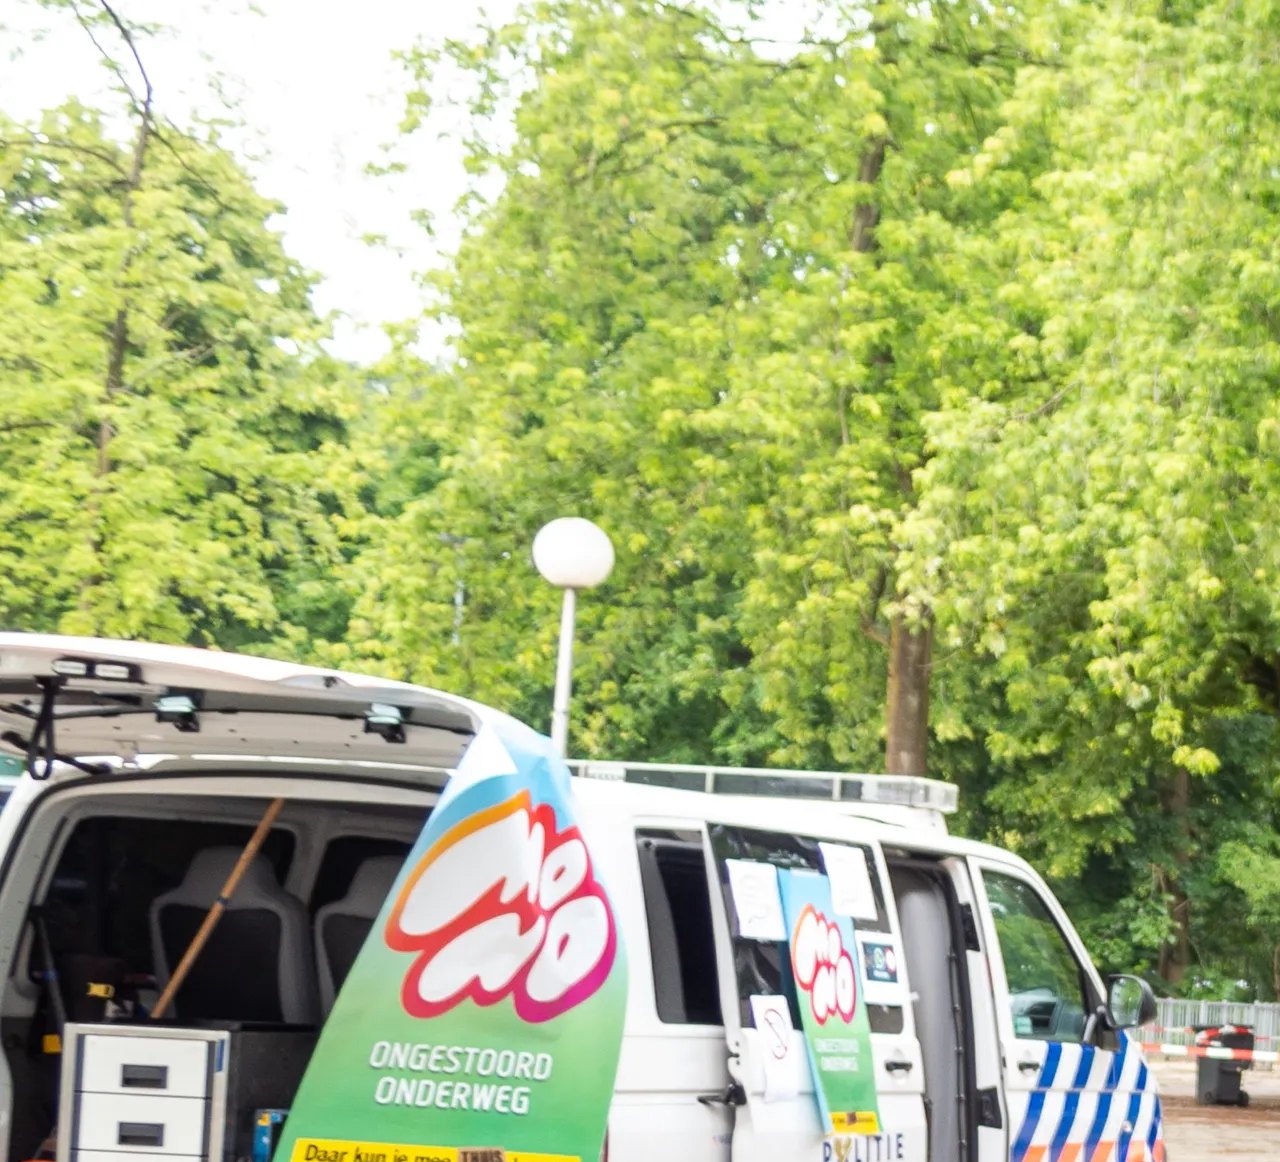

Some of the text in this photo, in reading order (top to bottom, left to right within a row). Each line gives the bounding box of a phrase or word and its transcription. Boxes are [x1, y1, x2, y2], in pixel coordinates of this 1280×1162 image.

[369, 1041, 553, 1081] ONGESTOORD
[374, 1076, 532, 1114] ONDERWEG
[304, 1144, 348, 1162] Daar
